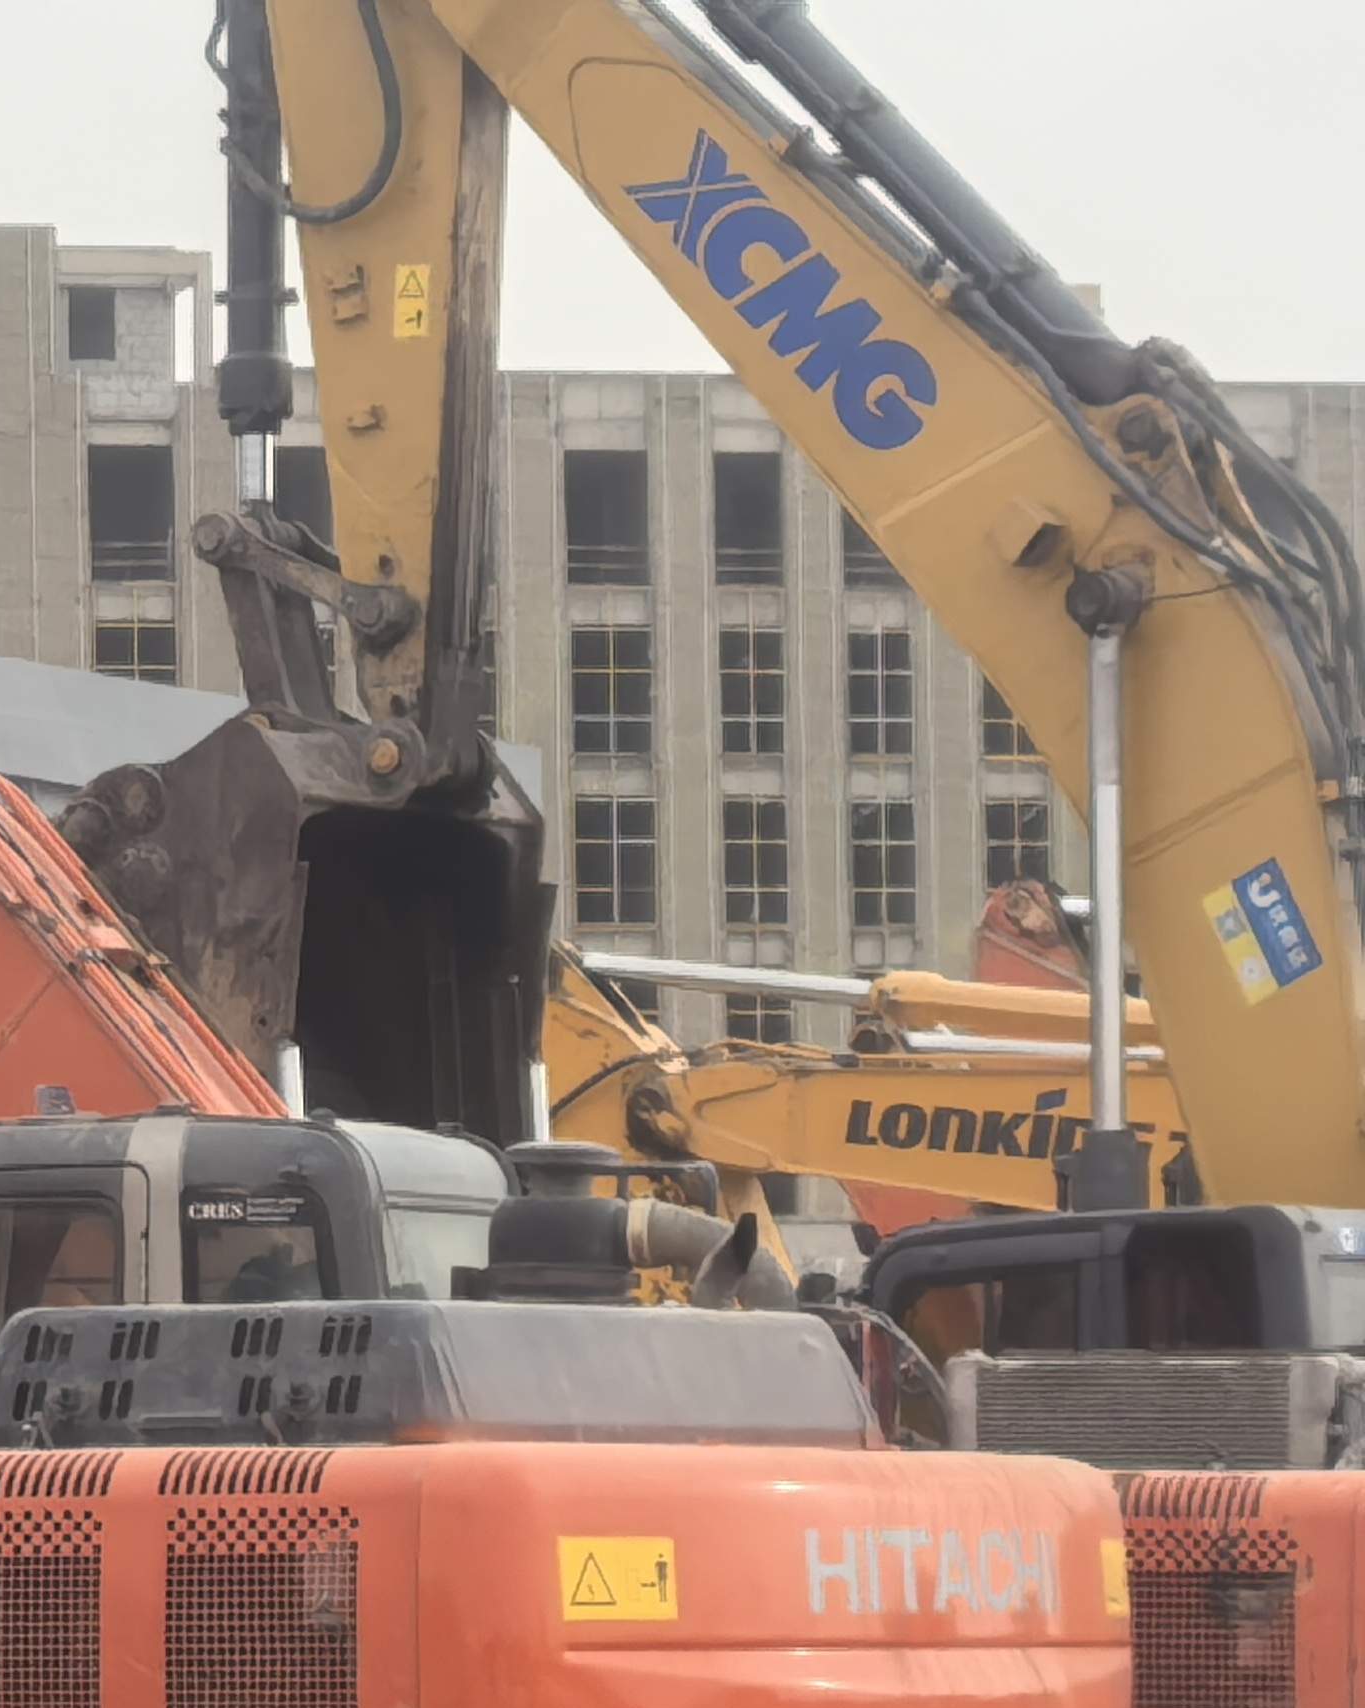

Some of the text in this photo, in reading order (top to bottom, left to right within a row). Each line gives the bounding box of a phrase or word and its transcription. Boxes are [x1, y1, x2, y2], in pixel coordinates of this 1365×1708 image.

[621, 128, 937, 450] XCMG
[187, 1200, 244, 1221] CRES
[805, 1527, 1059, 1615] HITACHI
